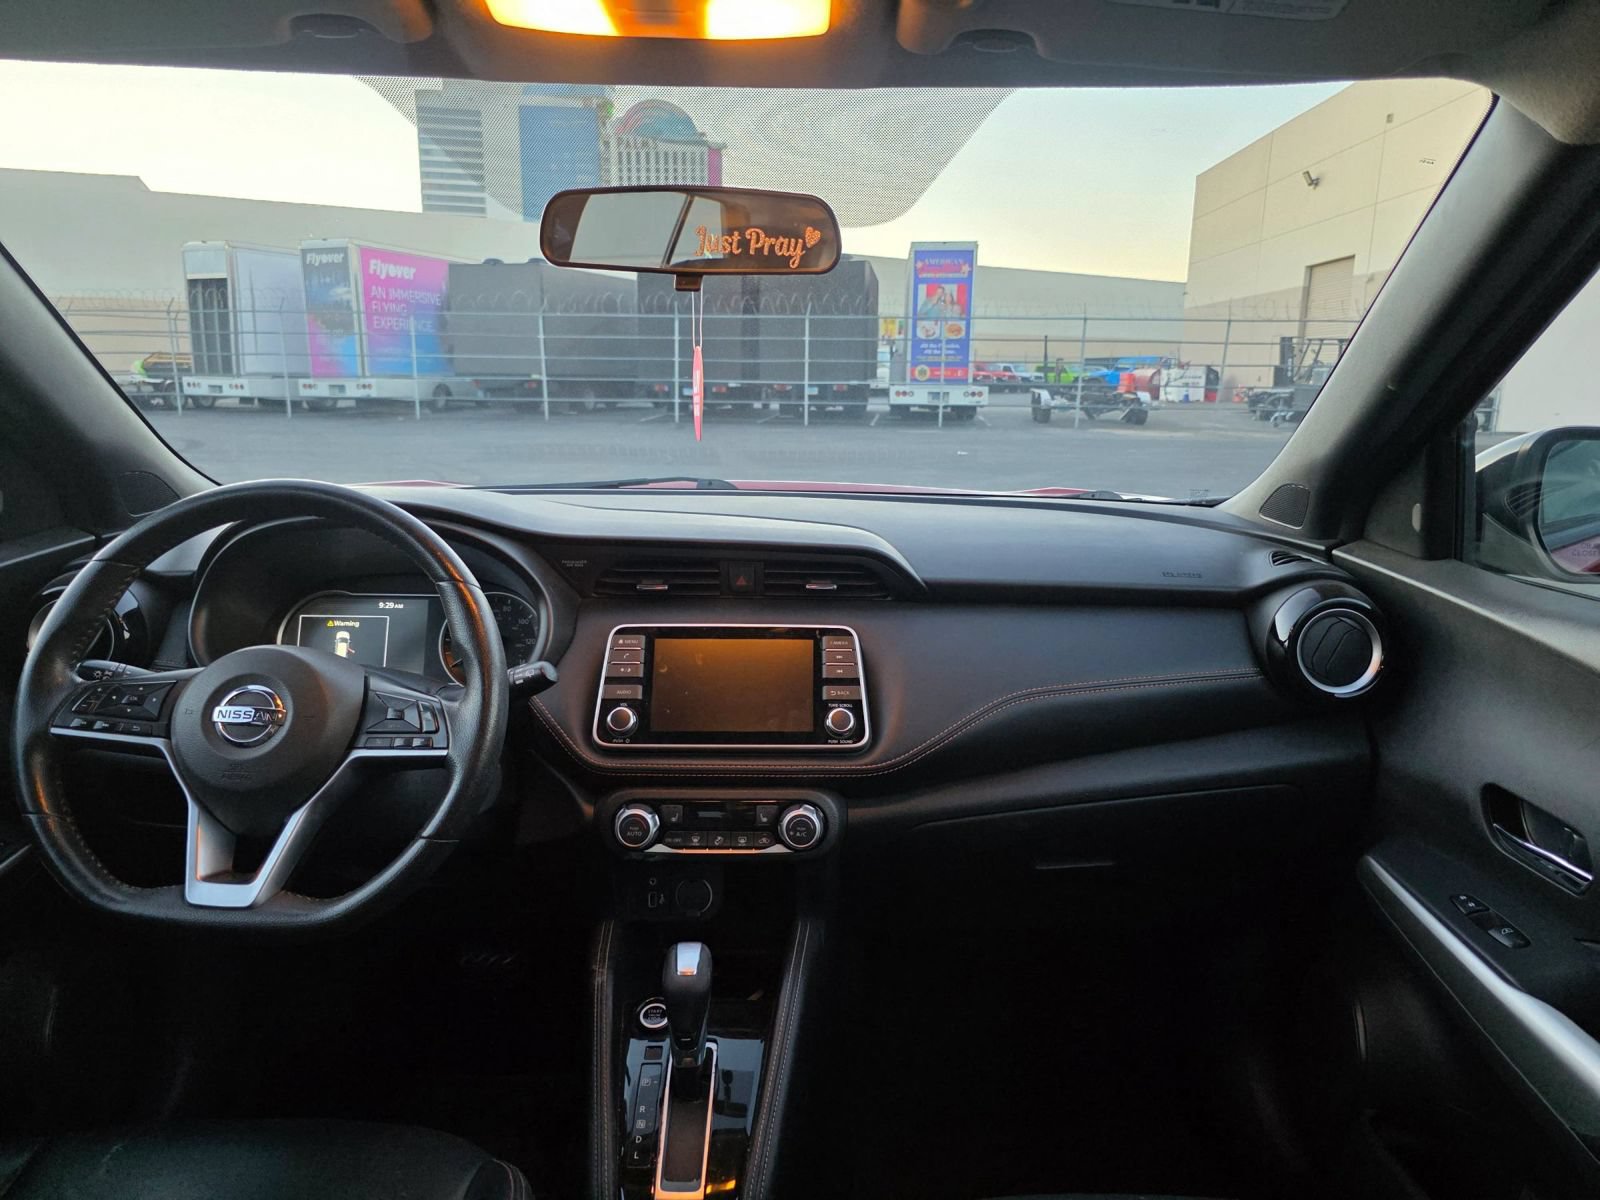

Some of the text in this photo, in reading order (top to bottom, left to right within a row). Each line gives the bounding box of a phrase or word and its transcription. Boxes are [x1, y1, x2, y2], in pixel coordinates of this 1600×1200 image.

[694, 225, 806, 269] Just Pray
[306, 253, 344, 266] Flyover
[368, 258, 416, 280] Flyover
[371, 285, 441, 306] AN IMMERSIVE
[374, 315, 433, 332] EXPERINCE
[334, 620, 360, 628] Warning
[217, 709, 278, 722] NISSAN
[639, 1105, 646, 1113] R
[635, 1135, 642, 1144] D
[633, 1151, 639, 1159] L
